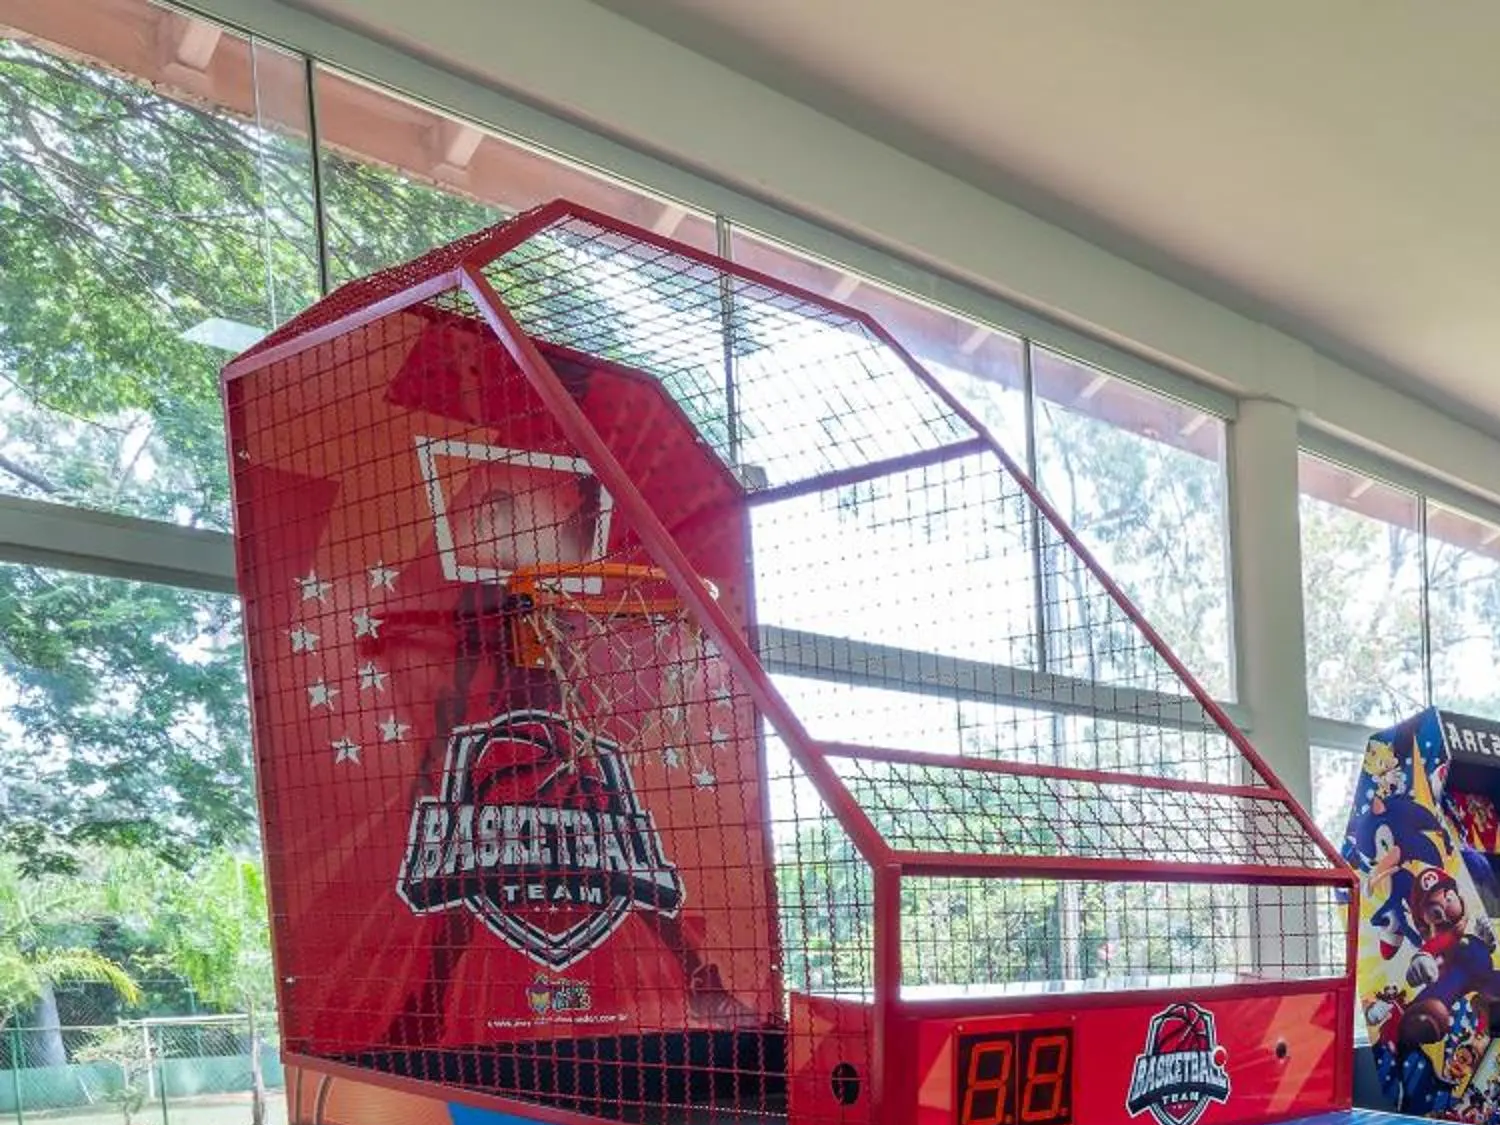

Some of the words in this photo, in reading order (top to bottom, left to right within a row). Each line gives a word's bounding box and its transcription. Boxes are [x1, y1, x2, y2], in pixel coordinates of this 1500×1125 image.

[409, 804, 677, 885] BASKETBALL
[504, 884, 602, 904] TEAM
[1162, 1091, 1200, 1104] TEAM
